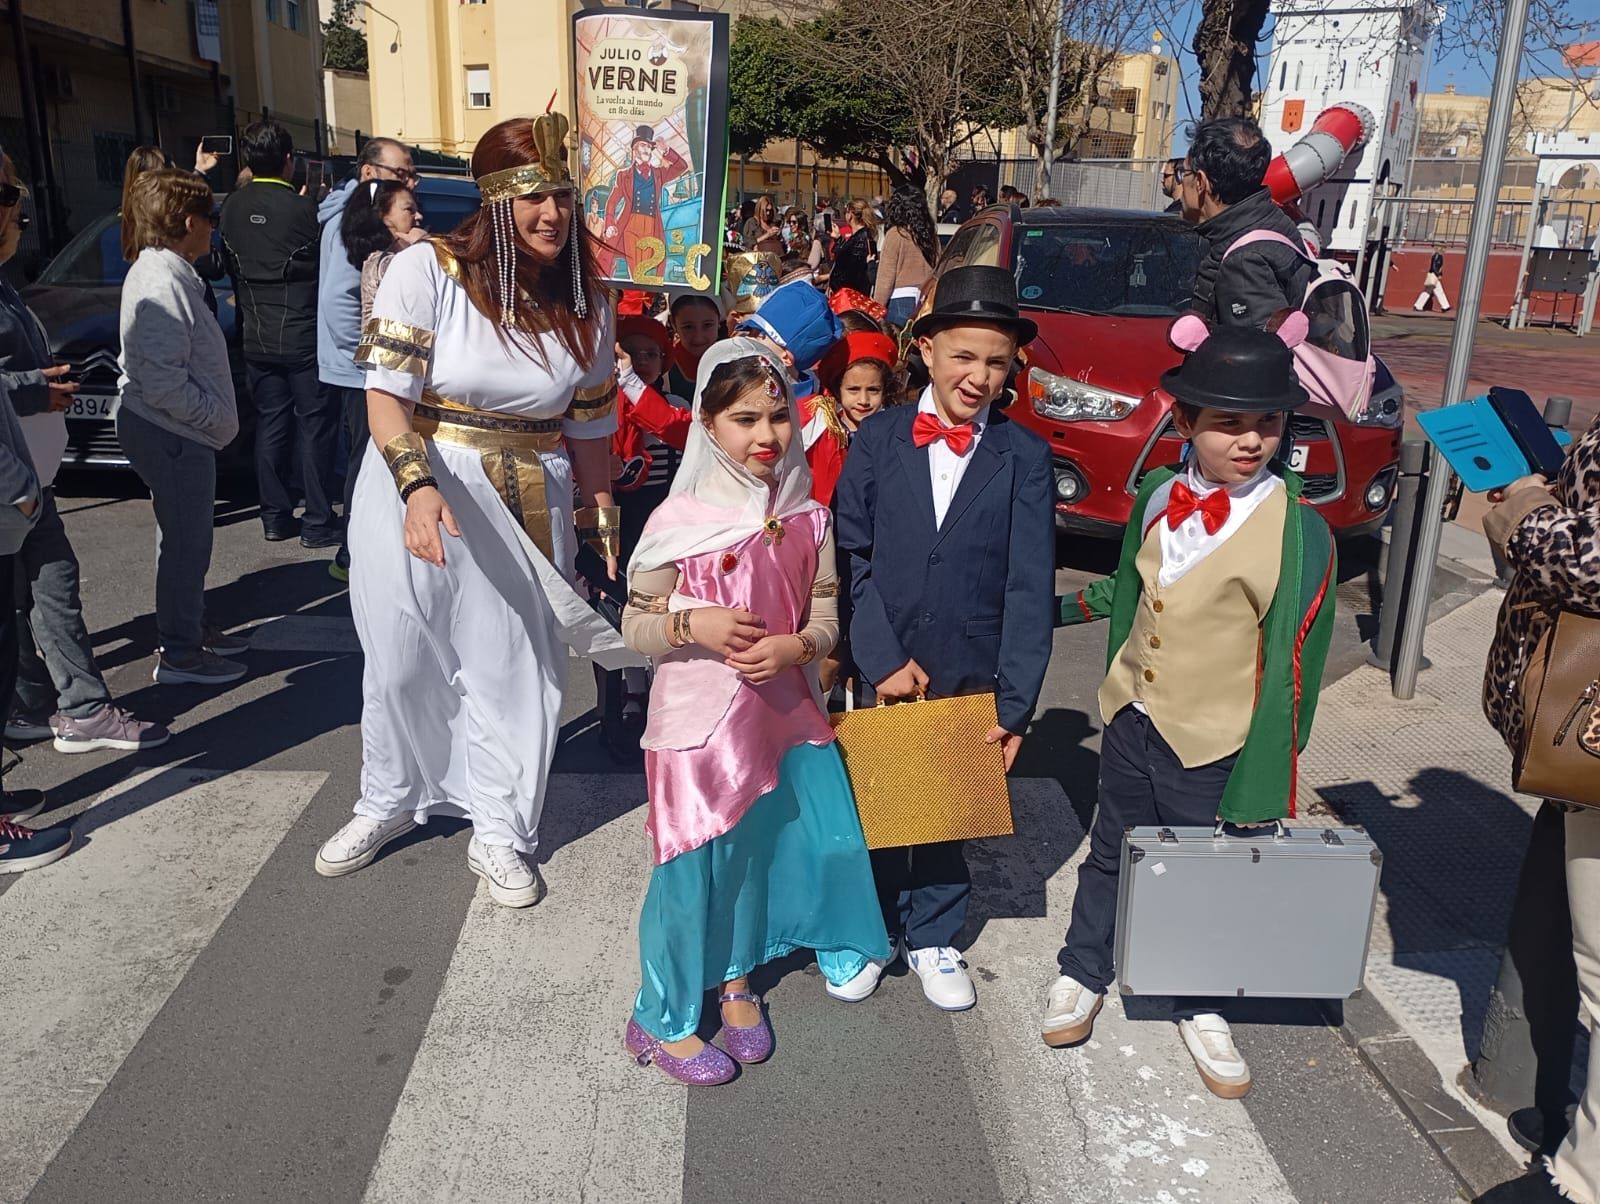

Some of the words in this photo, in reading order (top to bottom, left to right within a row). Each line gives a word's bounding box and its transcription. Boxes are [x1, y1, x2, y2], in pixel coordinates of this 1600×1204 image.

[599, 48, 642, 61] JULIO
[588, 66, 677, 94] VERNE
[596, 95, 605, 104] La
[605, 95, 626, 105] vuelta
[627, 96, 635, 105] al
[636, 98, 664, 108] mundo
[619, 105, 629, 115] 80
[630, 106, 645, 116] días
